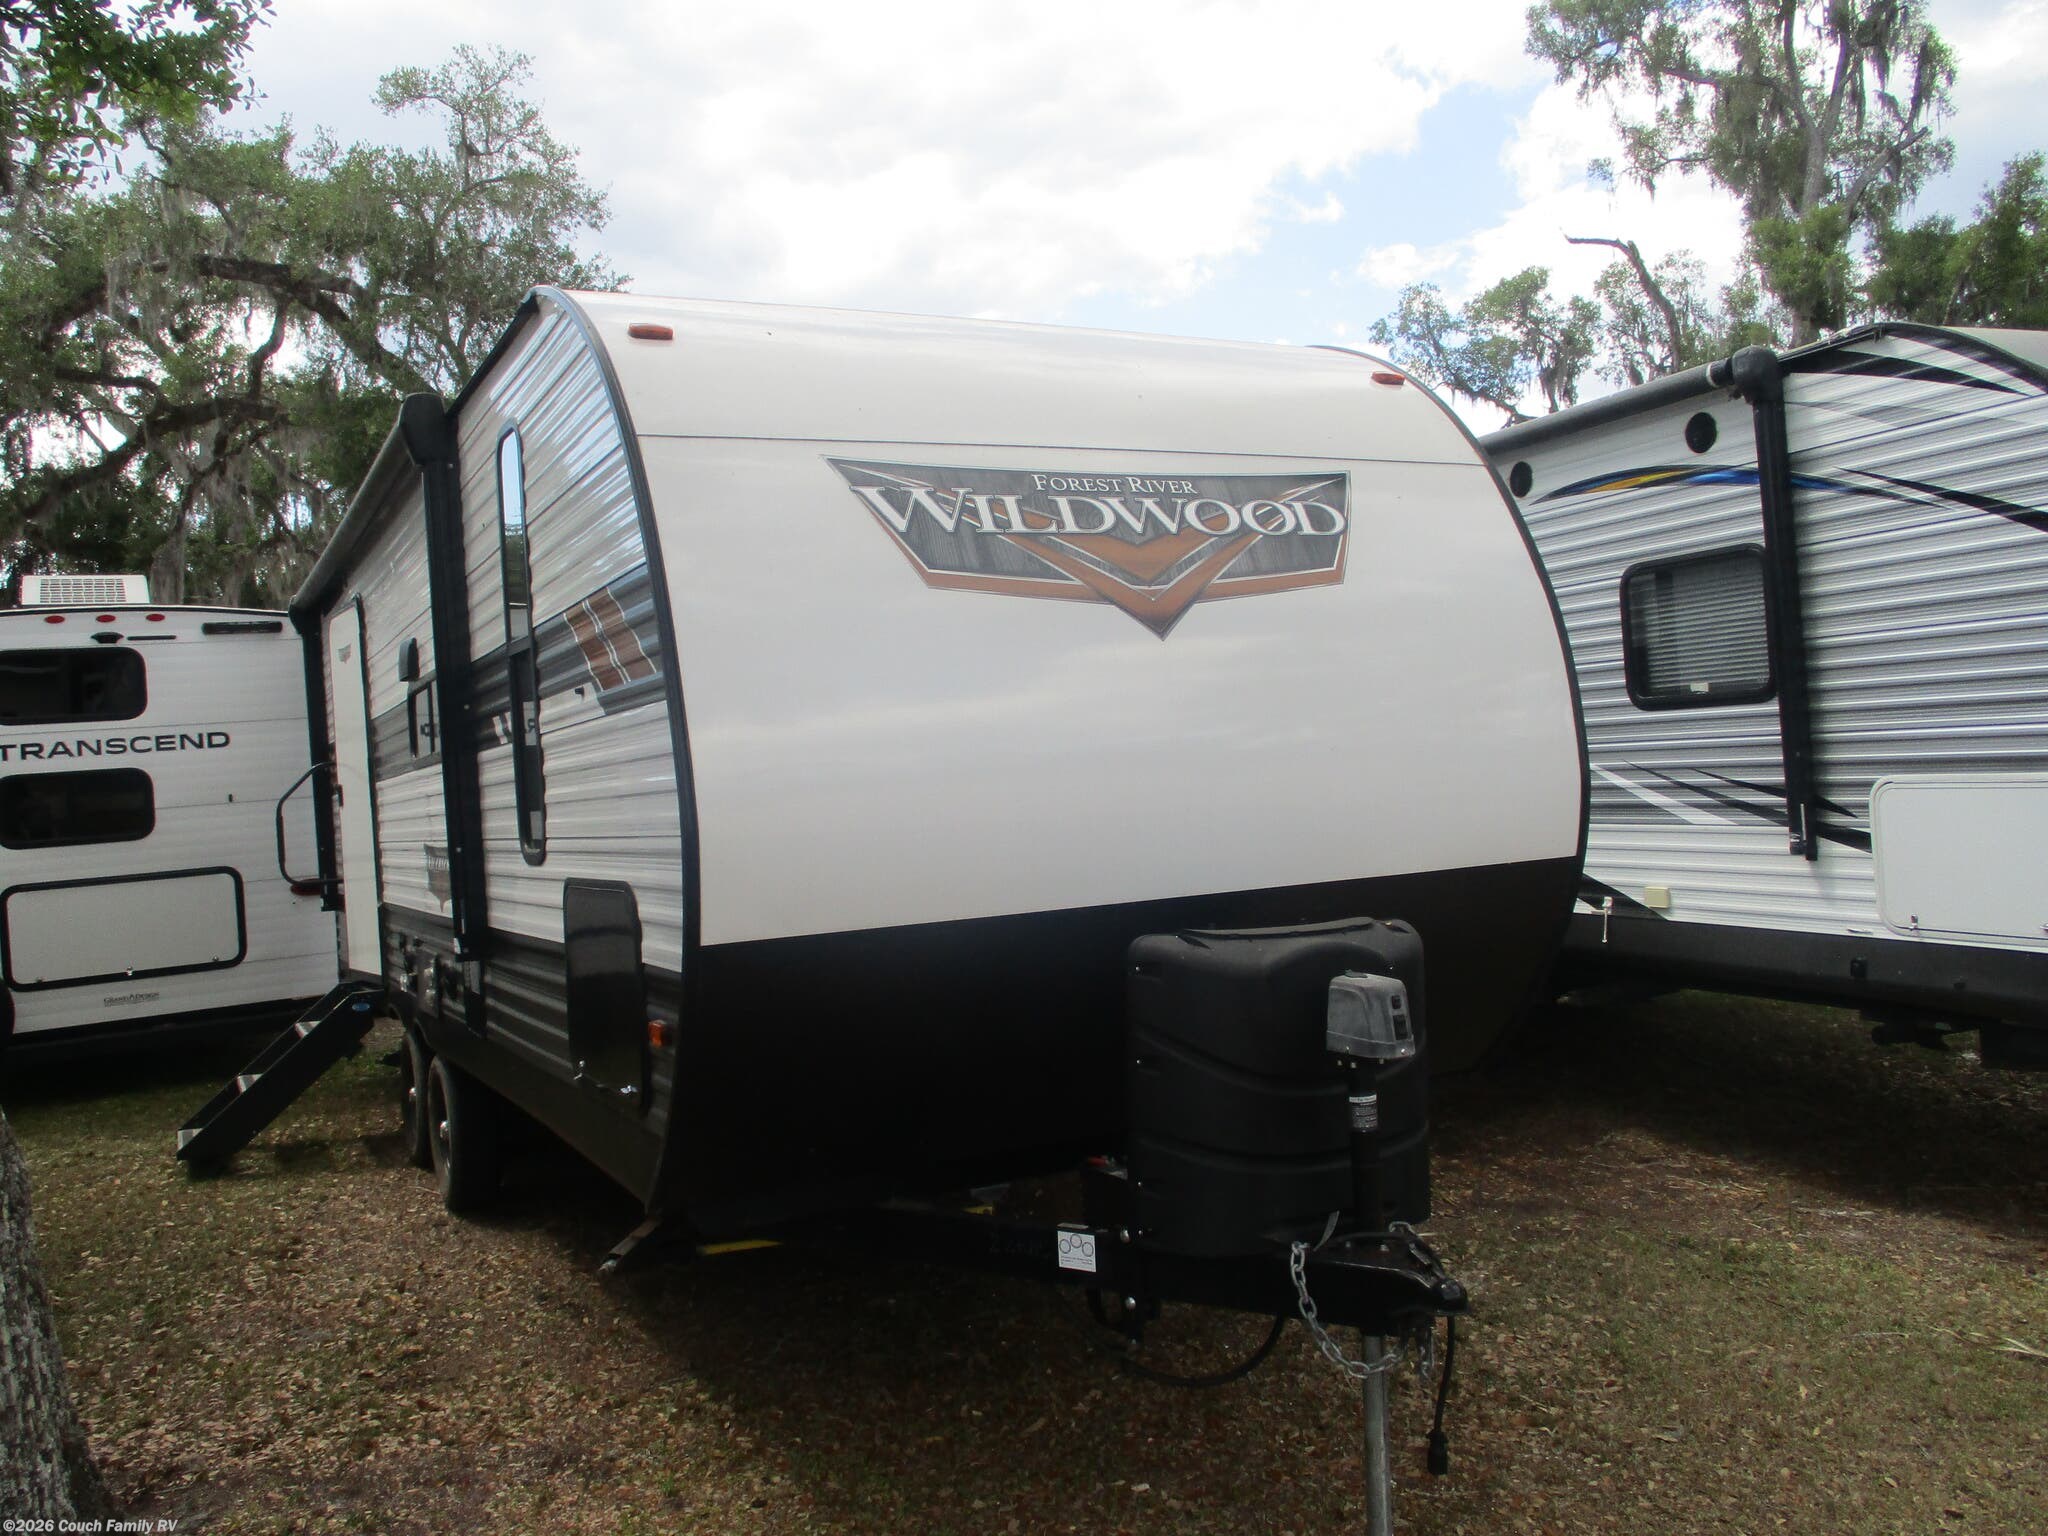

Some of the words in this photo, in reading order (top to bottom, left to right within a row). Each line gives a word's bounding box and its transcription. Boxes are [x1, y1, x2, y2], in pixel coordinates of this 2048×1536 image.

[1032, 474, 1122, 493] FOREST
[1127, 476, 1198, 495] RIVER
[849, 485, 1346, 536] WILDWOOD
[0, 732, 231, 761] TRANSCEND
